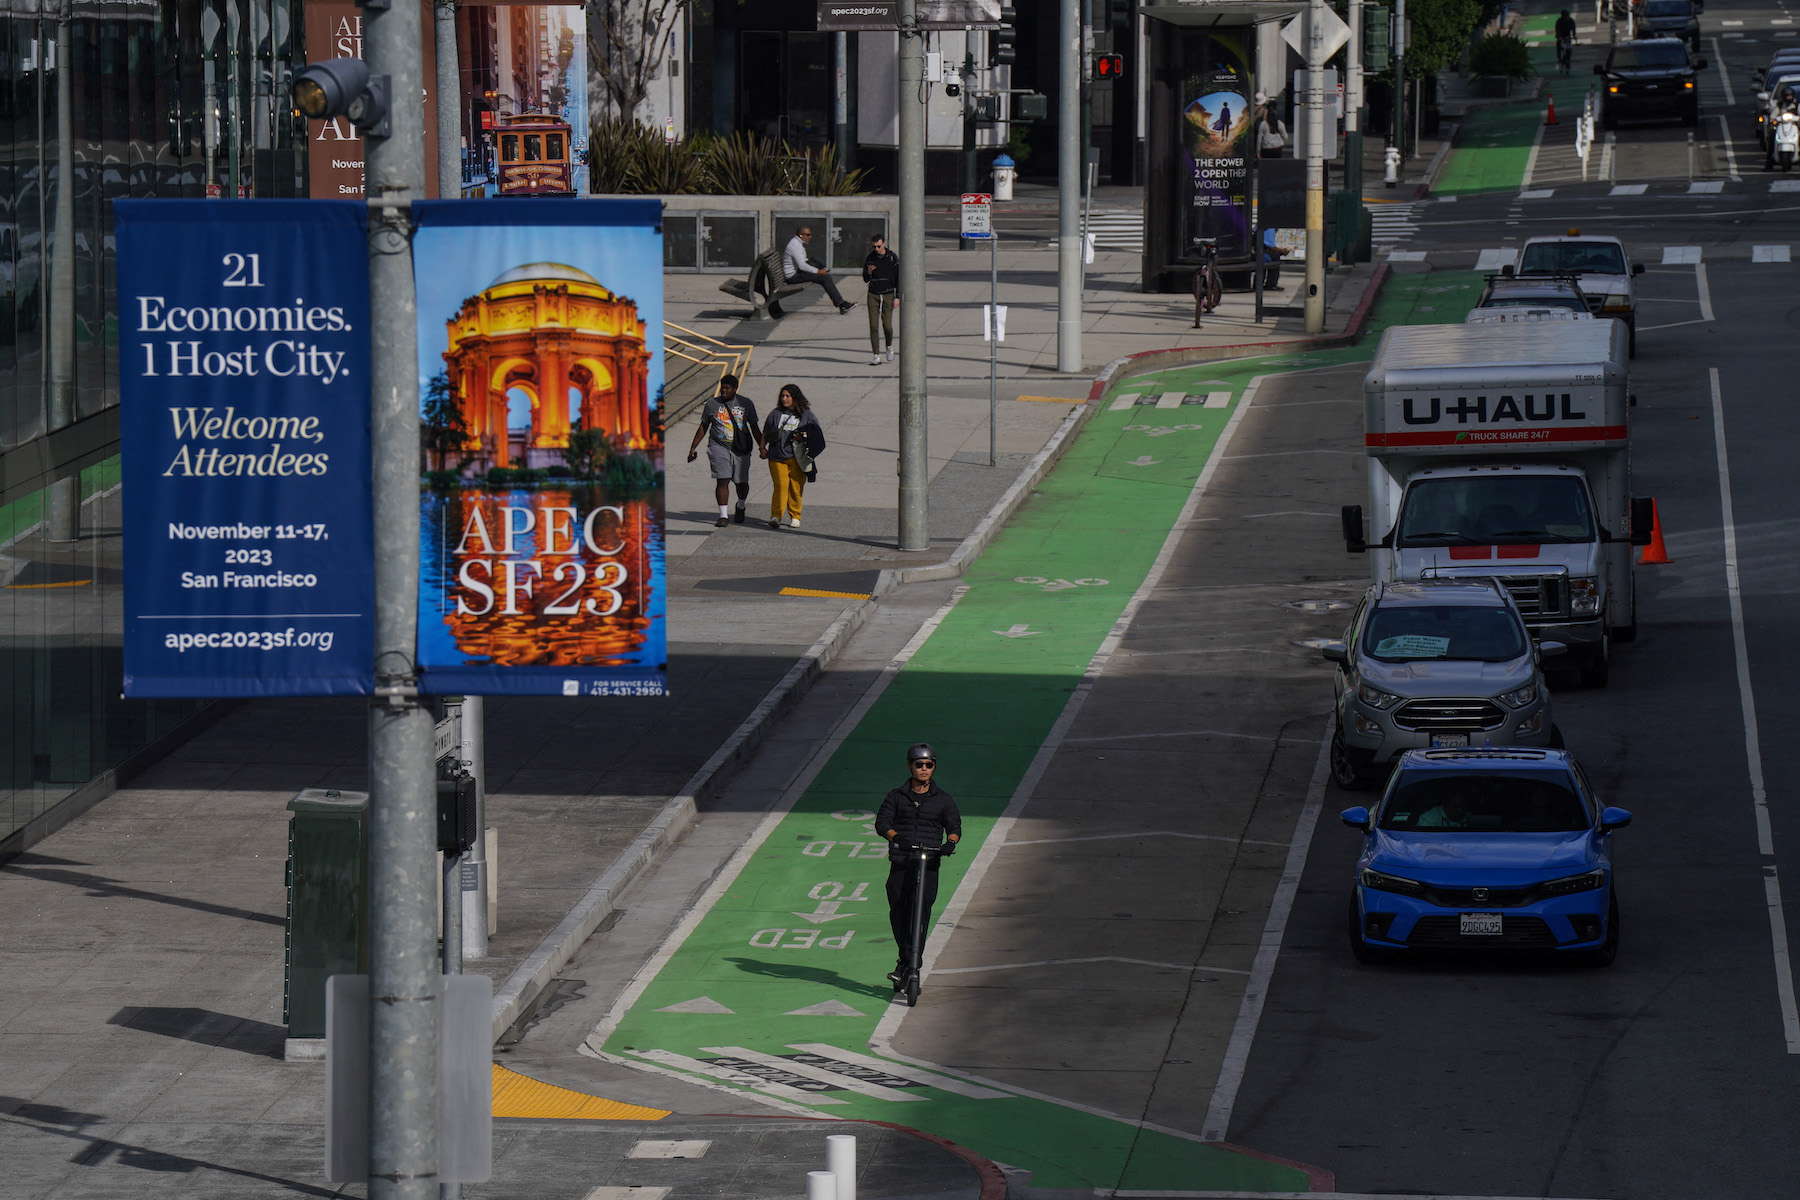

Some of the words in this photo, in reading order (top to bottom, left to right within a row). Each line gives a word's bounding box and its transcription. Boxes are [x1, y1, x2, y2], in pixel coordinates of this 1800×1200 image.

[831, 7, 888, 16] apec2023sf.org
[332, 160, 366, 169] Novem
[1194, 158, 1214, 167] THE
[1215, 158, 1244, 167] POWER
[1194, 169, 1200, 178] 2
[1201, 169, 1227, 178] OPEN
[339, 185, 357, 194] San
[1194, 180, 1230, 189] WORLD
[222, 253, 264, 287] 21
[136, 297, 352, 331] Economies.
[141, 343, 160, 376] 1
[166, 341, 259, 376] Host
[264, 340, 350, 384] City.
[169, 406, 325, 443] Welcome,
[1469, 432, 1499, 441] TRUCK
[1500, 431, 1530, 440] SHARE
[1530, 430, 1550, 440] 24/7
[163, 443, 329, 476] Attendees
[168, 522, 271, 540] November
[274, 523, 329, 541] 11-17,
[453, 505, 625, 556] APEC
[225, 549, 273, 566] 2023
[181, 571, 218, 588] San
[223, 571, 318, 588] Francisco
[457, 559, 627, 616] SF23
[165, 627, 335, 652] apec2023sf.org
[590, 687, 663, 696] 415-431-2950
[802, 840, 889, 859] ELD
[807, 881, 870, 902] TO
[1462, 921, 1501, 933] 9DGC495
[748, 928, 856, 950] PED
